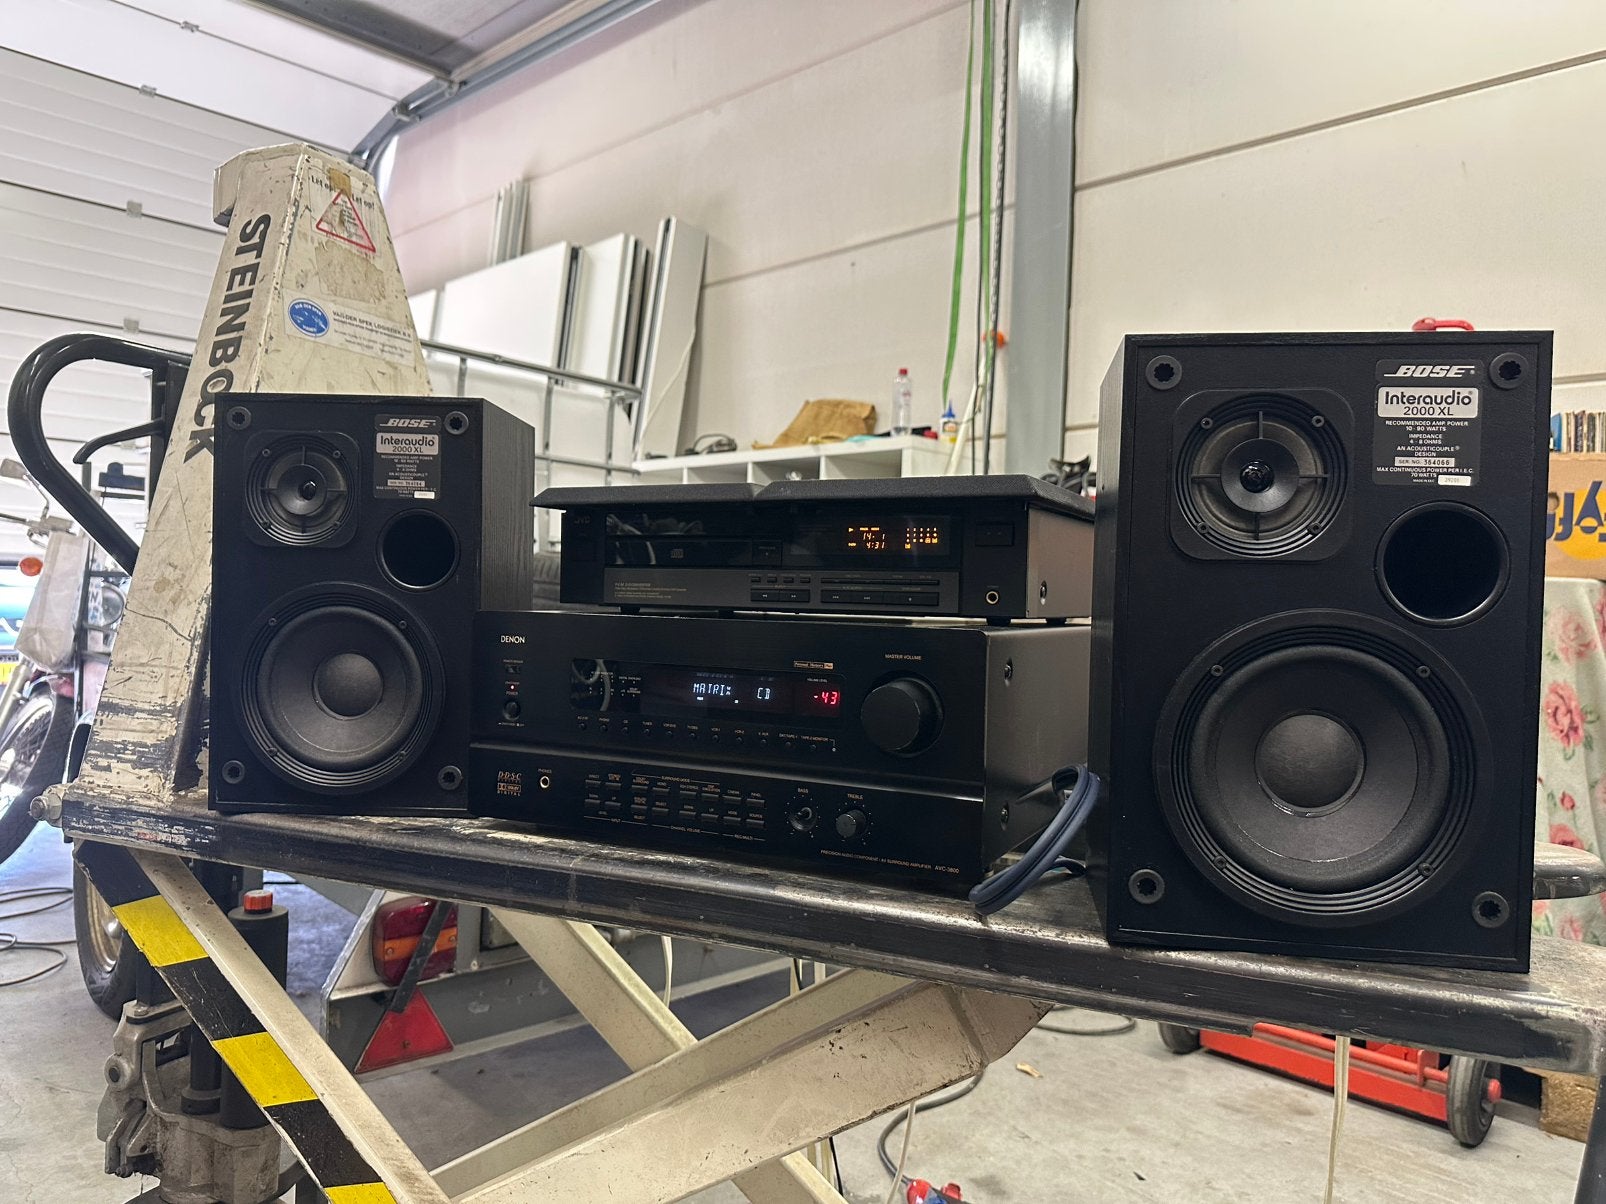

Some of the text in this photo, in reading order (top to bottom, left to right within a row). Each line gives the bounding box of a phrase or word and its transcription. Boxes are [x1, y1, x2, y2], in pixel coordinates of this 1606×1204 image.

[1384, 366, 1475, 378] BOSE
[1385, 390, 1472, 406] Interaudio
[1403, 406, 1454, 416] 2000 XL
[380, 419, 436, 428] BOSE
[381, 436, 435, 447] Interaudio
[501, 636, 525, 644] DENON
[693, 683, 771, 699] MATRIX CD
